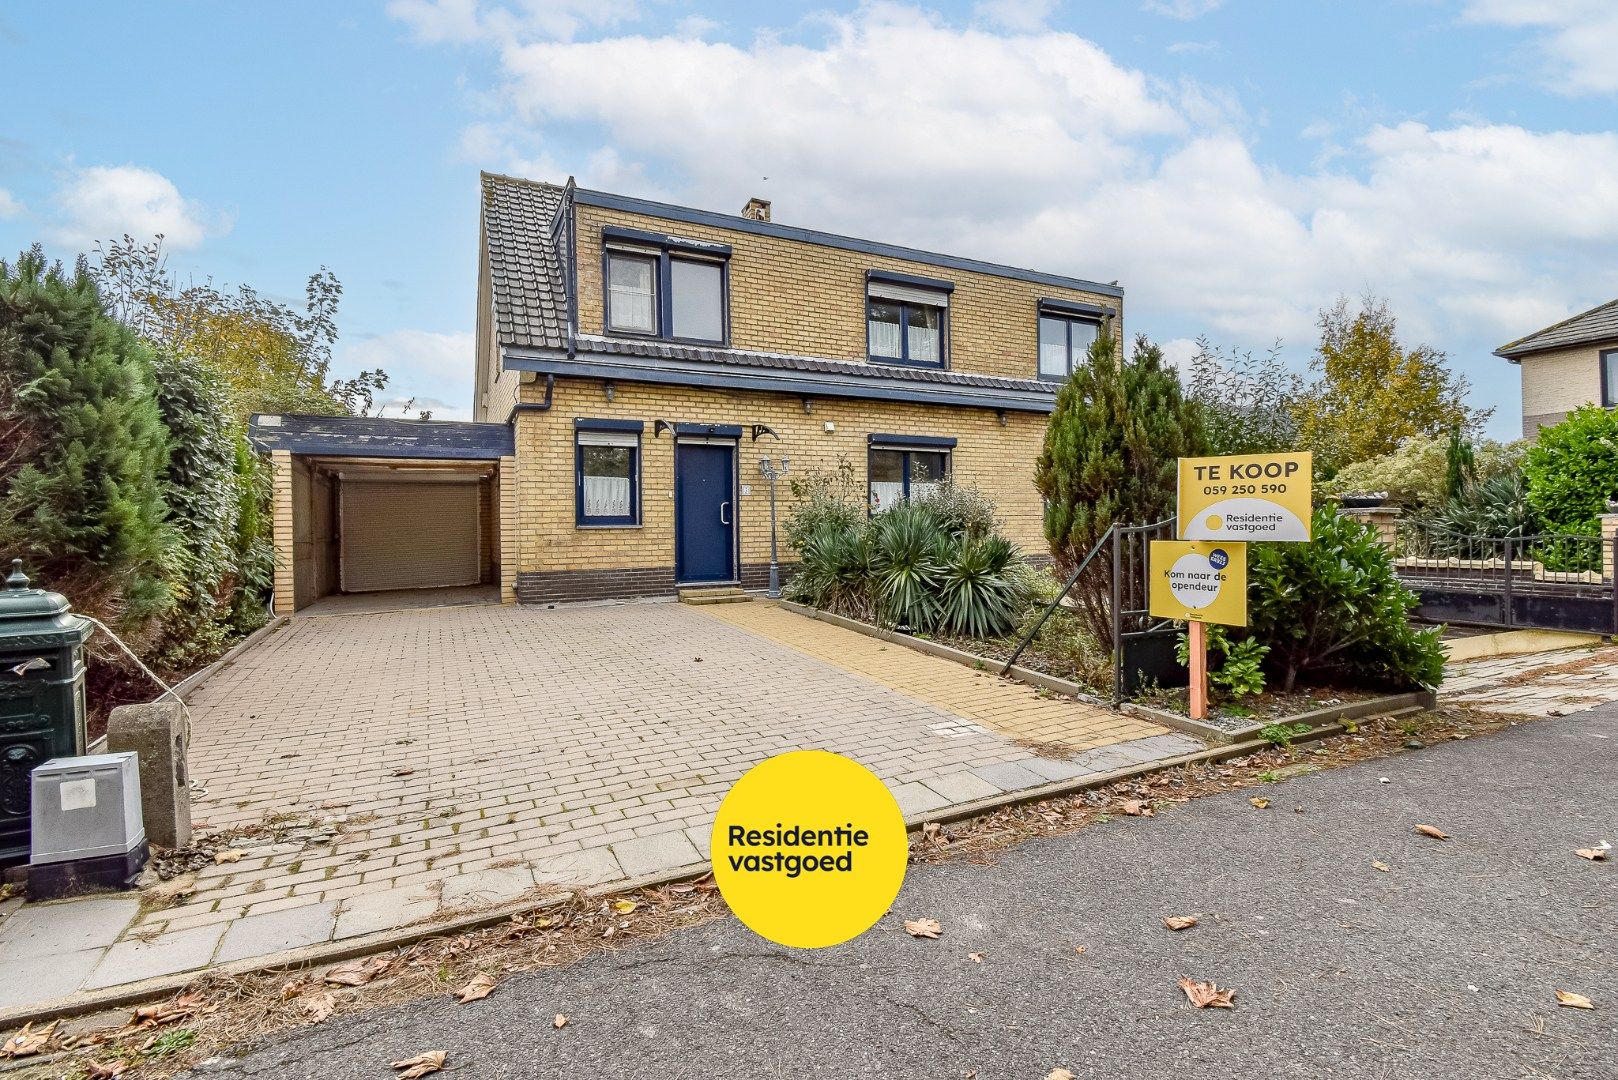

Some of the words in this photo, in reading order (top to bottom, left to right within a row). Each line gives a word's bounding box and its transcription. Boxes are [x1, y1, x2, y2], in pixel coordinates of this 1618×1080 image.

[1194, 465, 1220, 480] TE
[1229, 461, 1299, 480] KOOP
[1203, 485, 1227, 495] 059
[1232, 484, 1256, 494] 250
[1261, 483, 1287, 494] 590
[1226, 513, 1283, 523] Residentie
[1226, 523, 1276, 533] vastgoed
[1164, 569, 1184, 579] Kom
[1187, 572, 1210, 581] naar
[1213, 571, 1227, 582] de
[1171, 582, 1218, 592] opendeur
